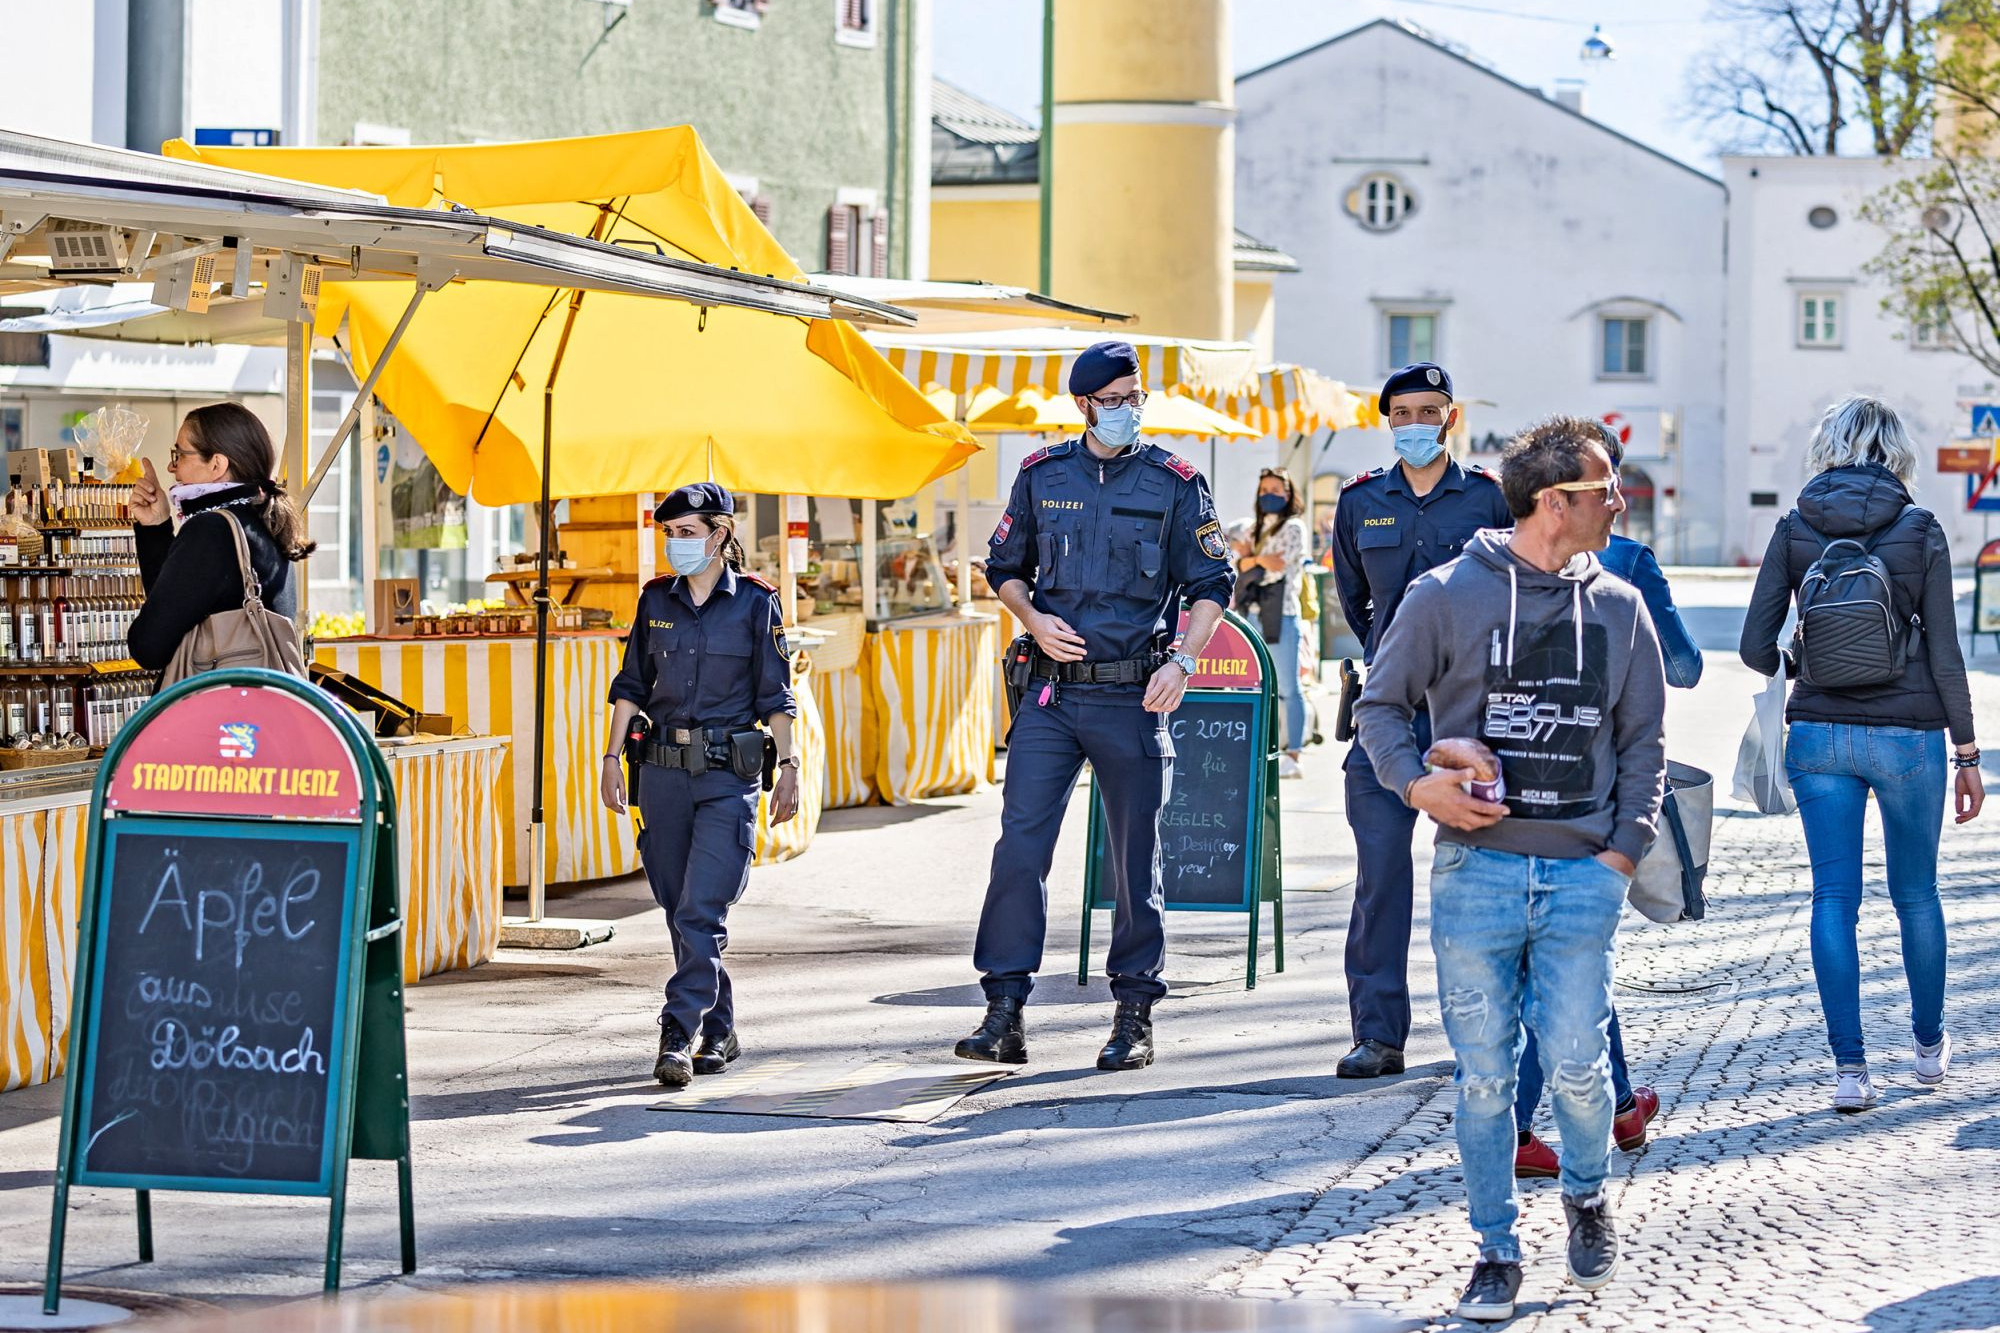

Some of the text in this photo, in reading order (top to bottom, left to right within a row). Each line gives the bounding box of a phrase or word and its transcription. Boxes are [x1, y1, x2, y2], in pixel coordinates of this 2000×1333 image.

[1041, 499, 1085, 511] POLIZEI
[1364, 516, 1396, 528] POLIZEI
[1210, 658, 1249, 677] LIENZ
[1487, 692, 1537, 706] STAY
[1195, 718, 1248, 742] 2019
[131, 762, 341, 798] STADTMARKT LIENZ
[138, 847, 321, 969] Äpfel
[138, 975, 213, 1009] aus
[151, 1021, 326, 1076] Dölsach
